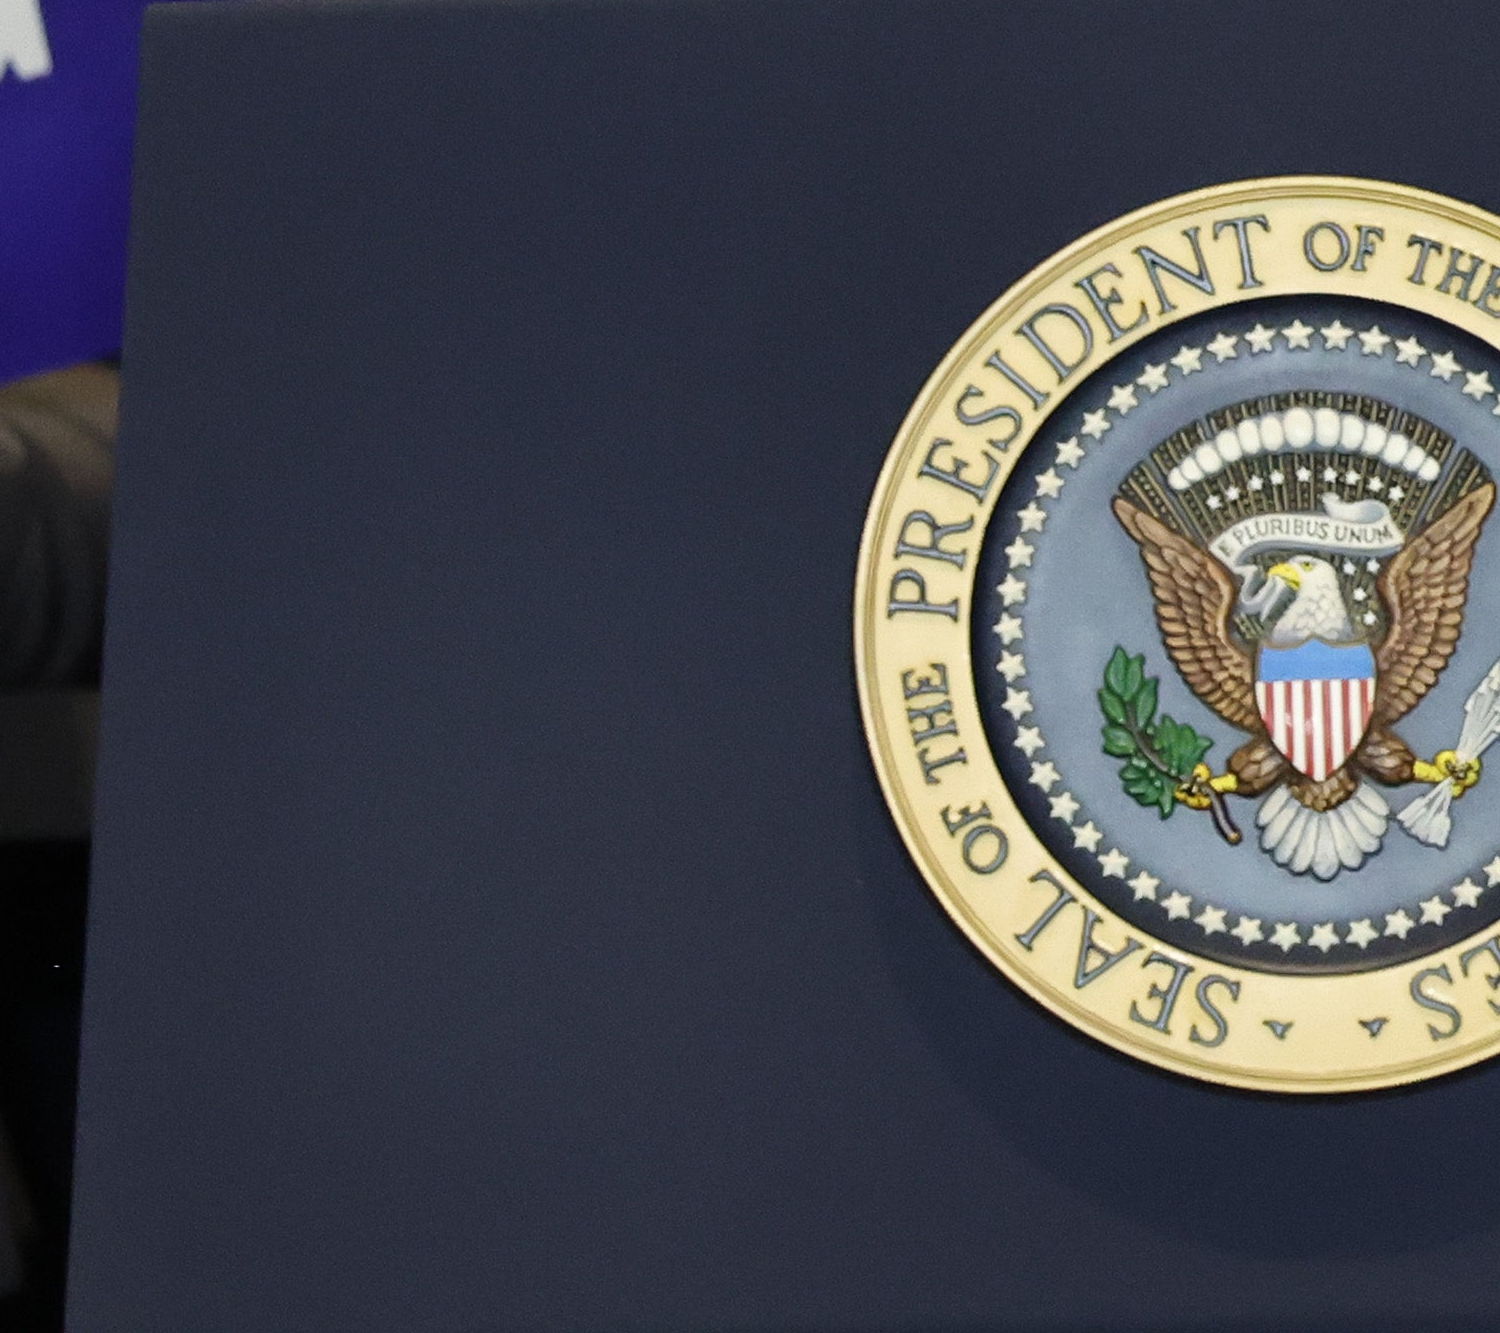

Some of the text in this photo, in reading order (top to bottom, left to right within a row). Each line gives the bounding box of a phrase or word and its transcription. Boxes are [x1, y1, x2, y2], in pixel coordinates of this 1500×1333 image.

[1302, 220, 1386, 274] OF
[886, 213, 1273, 623] PRESIDENT
[1230, 517, 1330, 546] PLURIBUS
[1333, 520, 1394, 545] UNUM
[901, 660, 969, 784] THE
[940, 799, 1011, 878] OF
[1016, 869, 1242, 1049] SEAL
